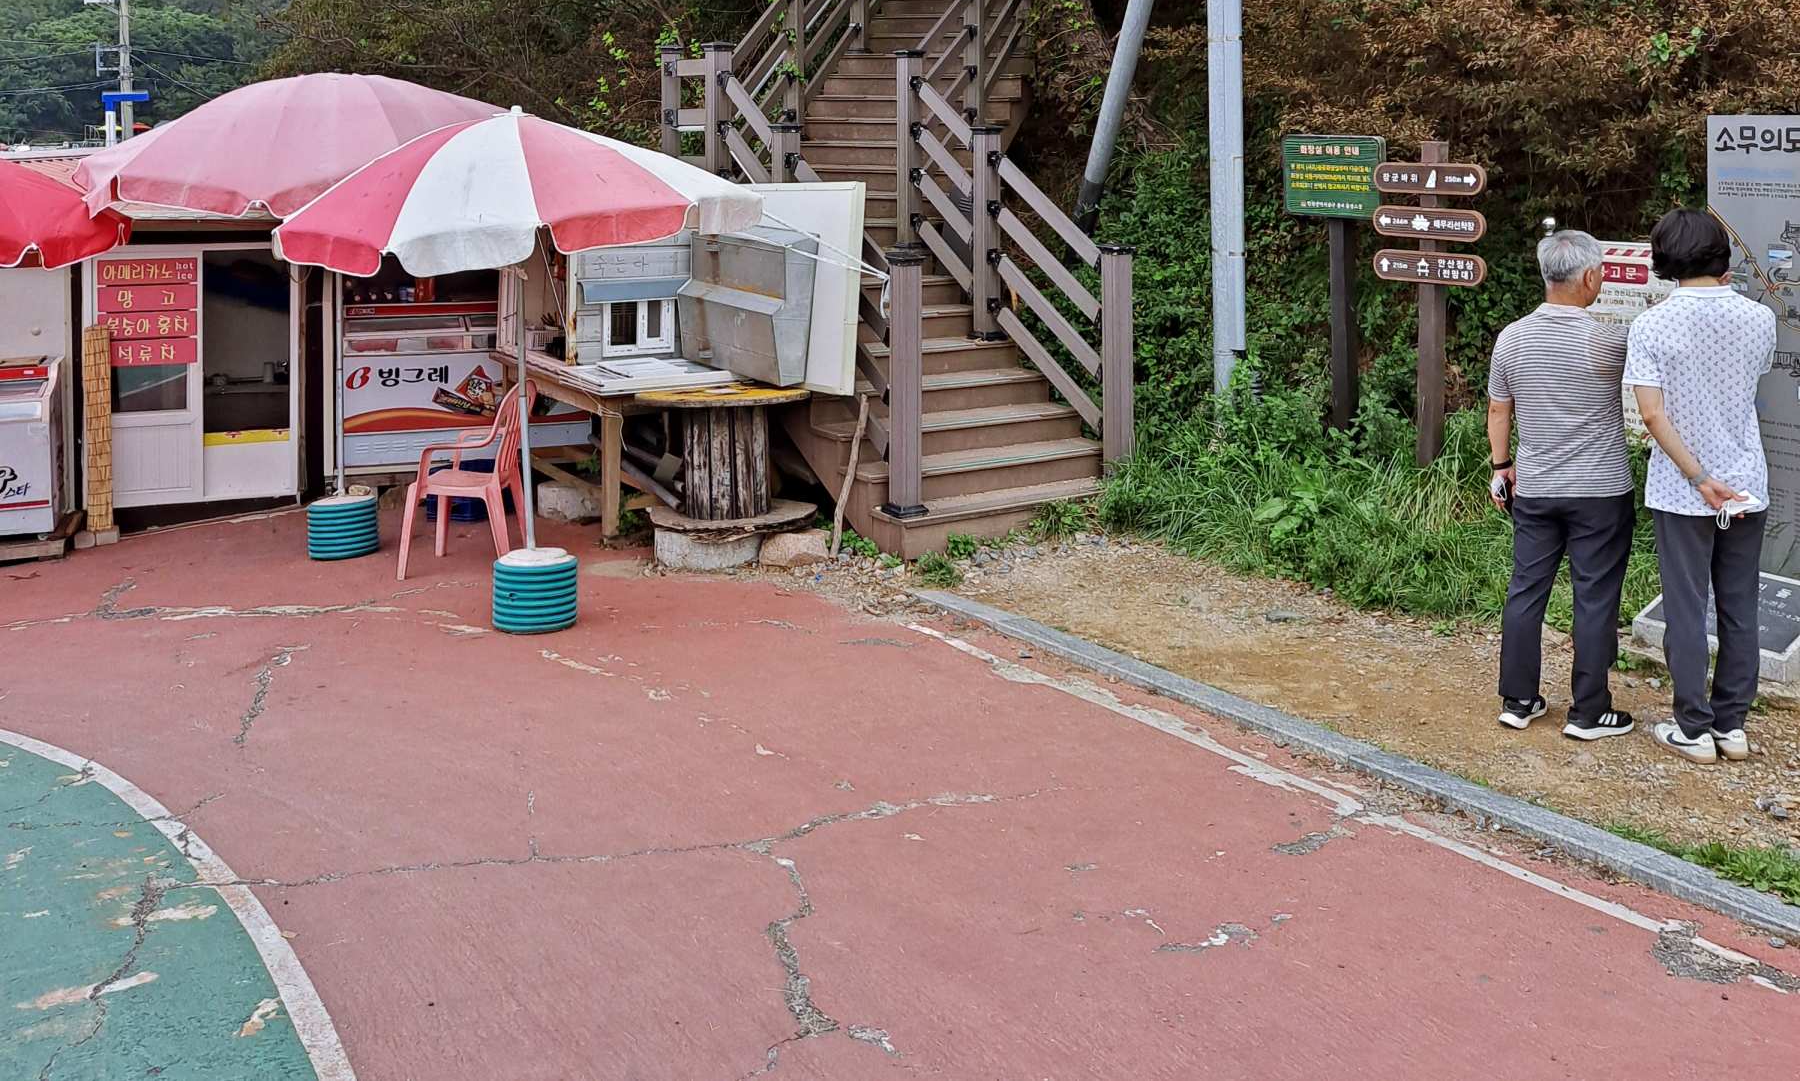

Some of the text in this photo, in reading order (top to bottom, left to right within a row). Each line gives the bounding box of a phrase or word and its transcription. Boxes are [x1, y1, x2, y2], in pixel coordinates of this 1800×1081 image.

[1715, 125, 1800, 155] 소무의도
[103, 263, 173, 280] 아메리카노
[175, 262, 194, 270] hot
[107, 314, 189, 337] 복숭아 홍차
[378, 365, 449, 387] 빙그레
[3, 482, 31, 499] 스타
